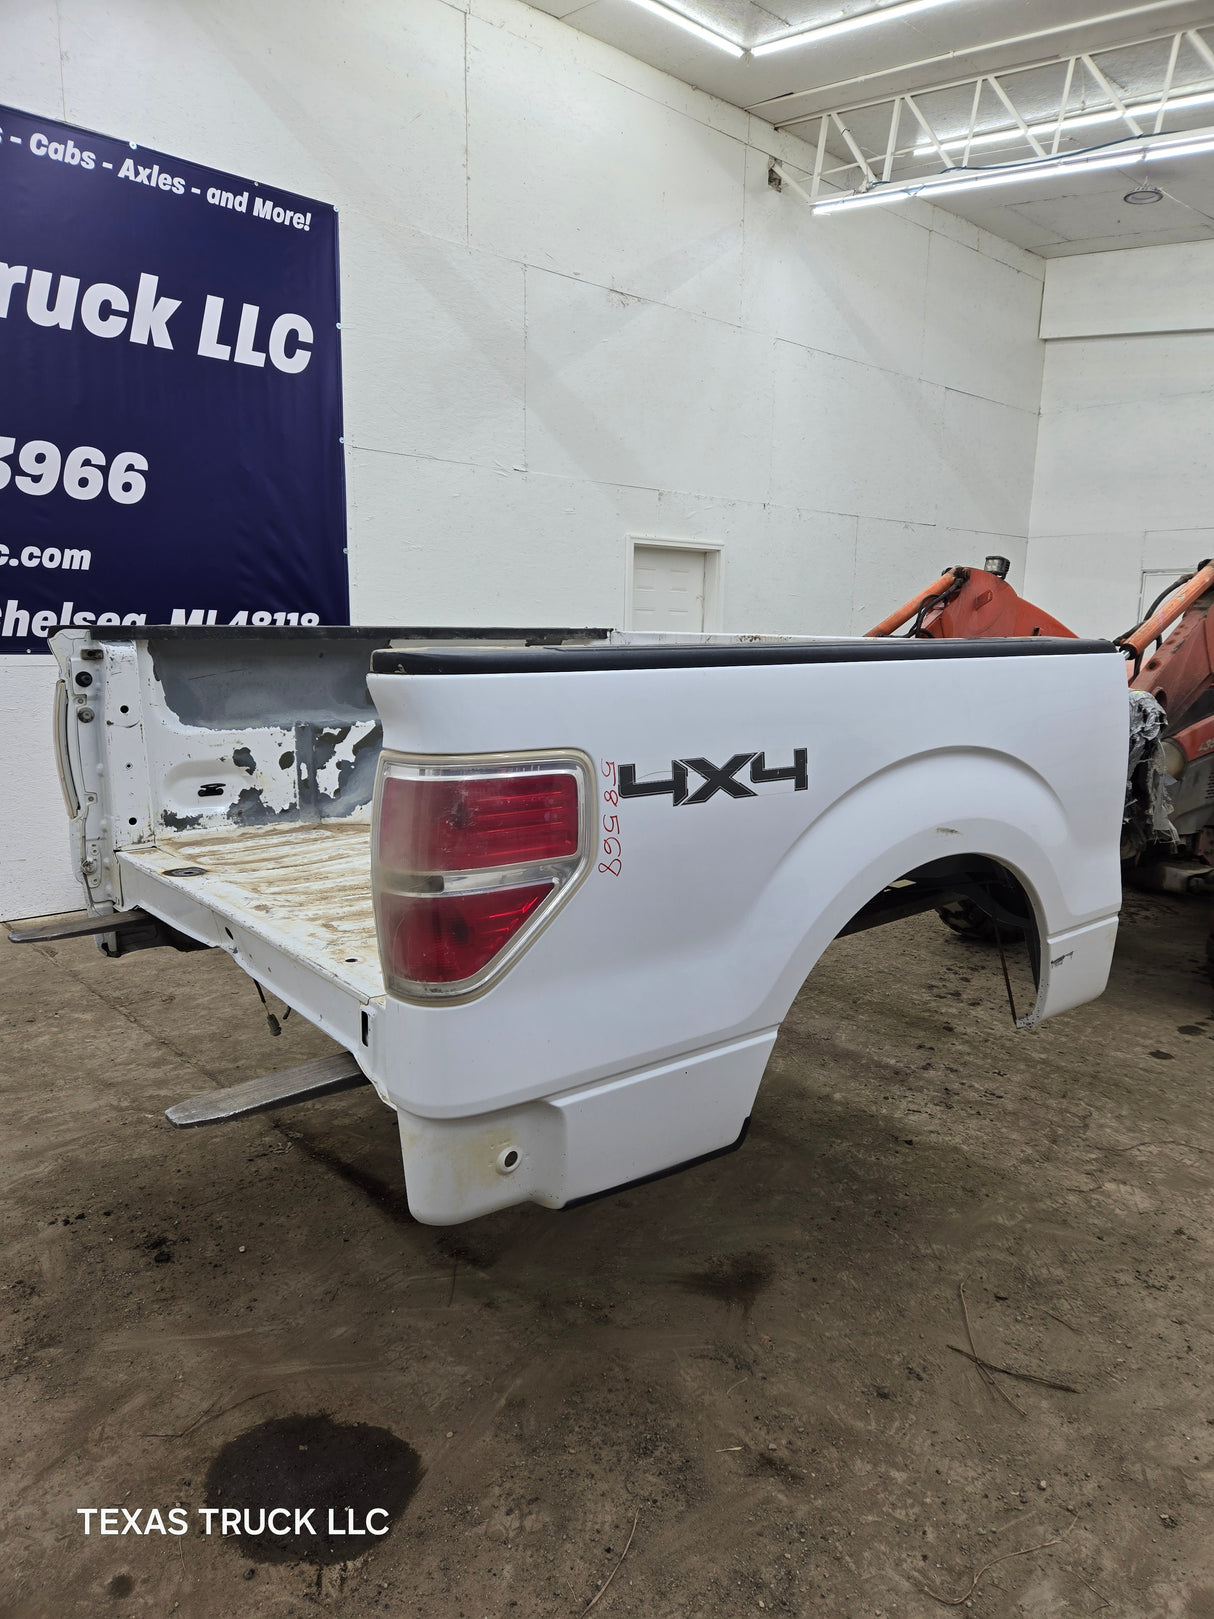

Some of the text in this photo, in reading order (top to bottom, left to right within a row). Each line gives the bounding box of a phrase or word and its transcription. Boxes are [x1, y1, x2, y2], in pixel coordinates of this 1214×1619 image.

[30, 133, 96, 169] Cabs
[118, 158, 186, 194] Axles
[207, 187, 249, 213] and
[253, 197, 312, 231] More!
[197, 295, 314, 374] LLC
[598, 758, 622, 876] 58568
[618, 748, 808, 807] 4X4
